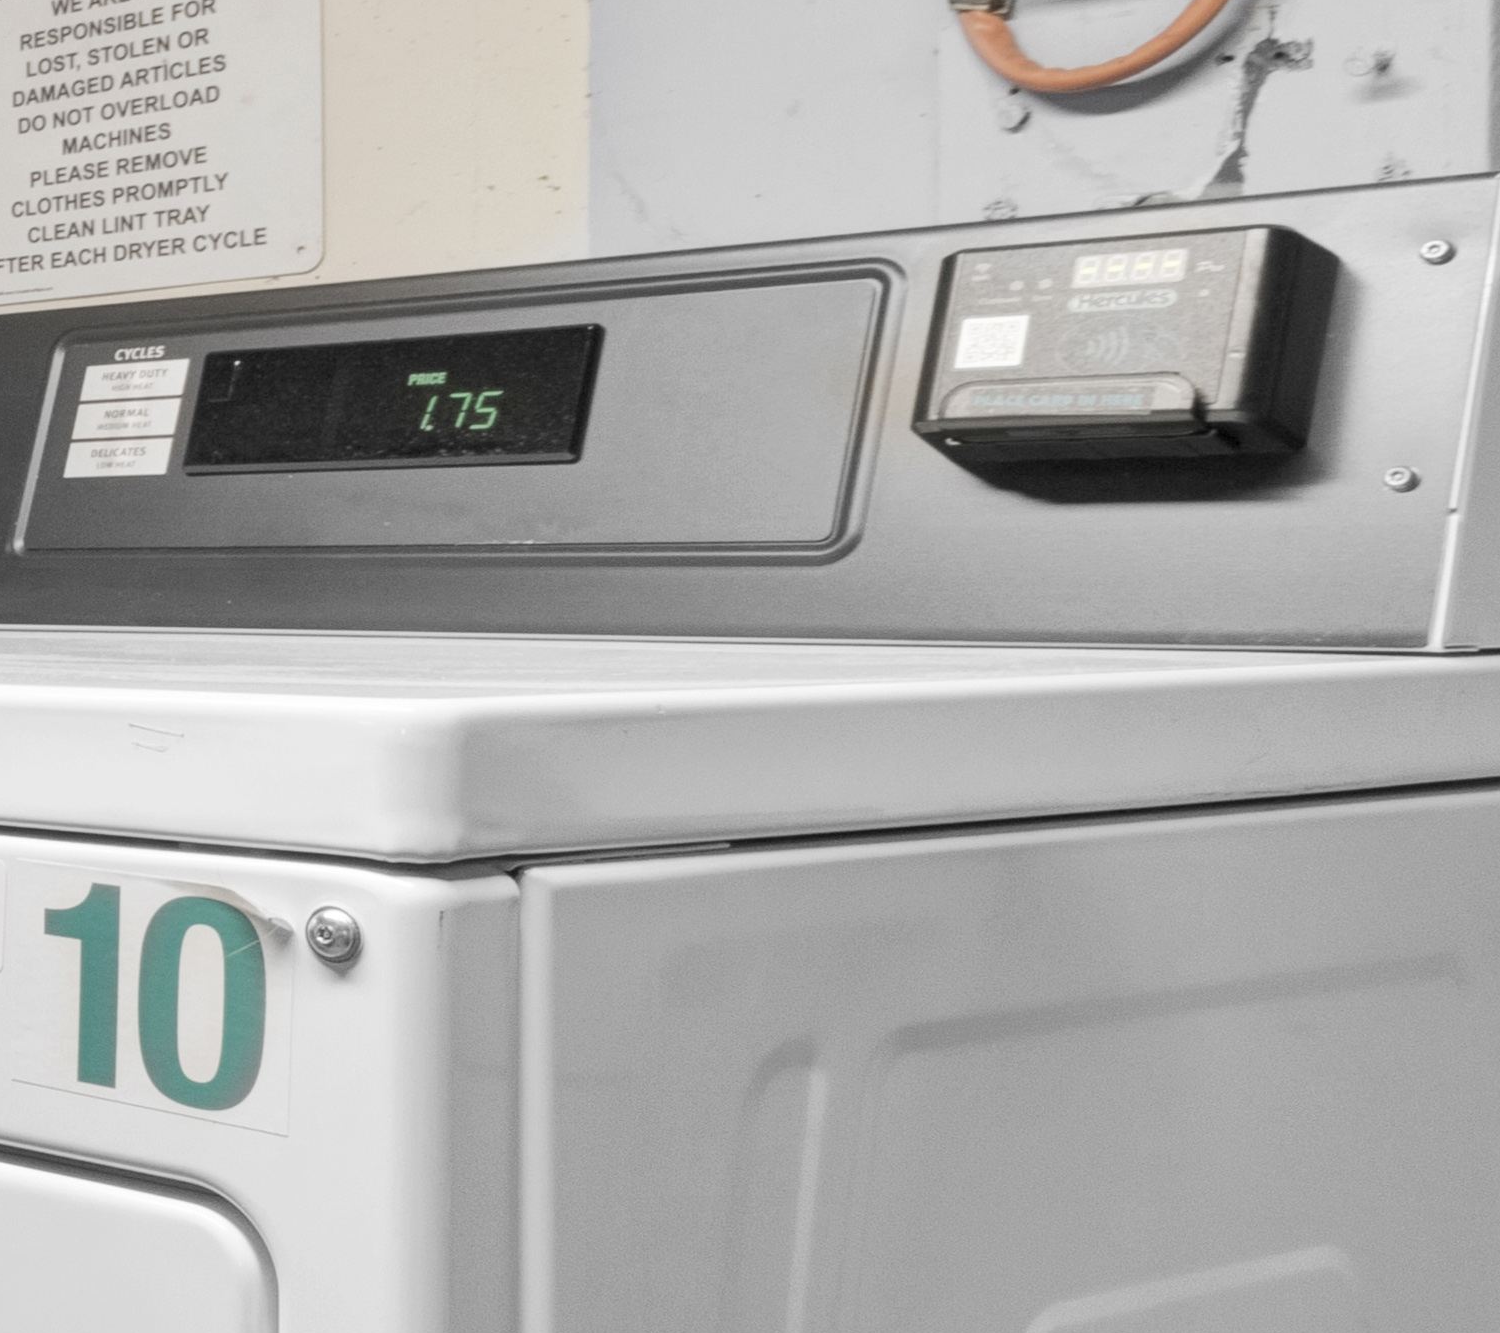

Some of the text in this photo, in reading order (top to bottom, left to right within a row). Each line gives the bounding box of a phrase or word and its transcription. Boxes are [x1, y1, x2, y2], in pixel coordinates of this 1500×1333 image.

[20, 7, 164, 51] RESPONSIBLE
[26, 28, 210, 79] LOST, STOLEN OR
[12, 54, 227, 108] DAMAGED ARTICLES
[18, 85, 221, 134] DO NOT OVERLOAD
[62, 123, 172, 155] MACHINES
[29, 146, 208, 188] PLEASE REMOVE
[11, 172, 229, 218] CLOTHES PROMPTLY
[27, 205, 210, 244] CLEAN LINT TRAY
[50, 246, 107, 269] EACH
[113, 237, 186, 263] DRYER
[192, 227, 268, 254] CYCLE
[114, 345, 166, 361] CYCLES
[102, 368, 169, 381] HEAVY DUTY
[407, 371, 448, 386] PRICE
[103, 408, 150, 419] NORMAL
[419, 390, 505, 432] 1.75
[90, 446, 147, 458] DELICATES
[44, 882, 267, 1112] 10
